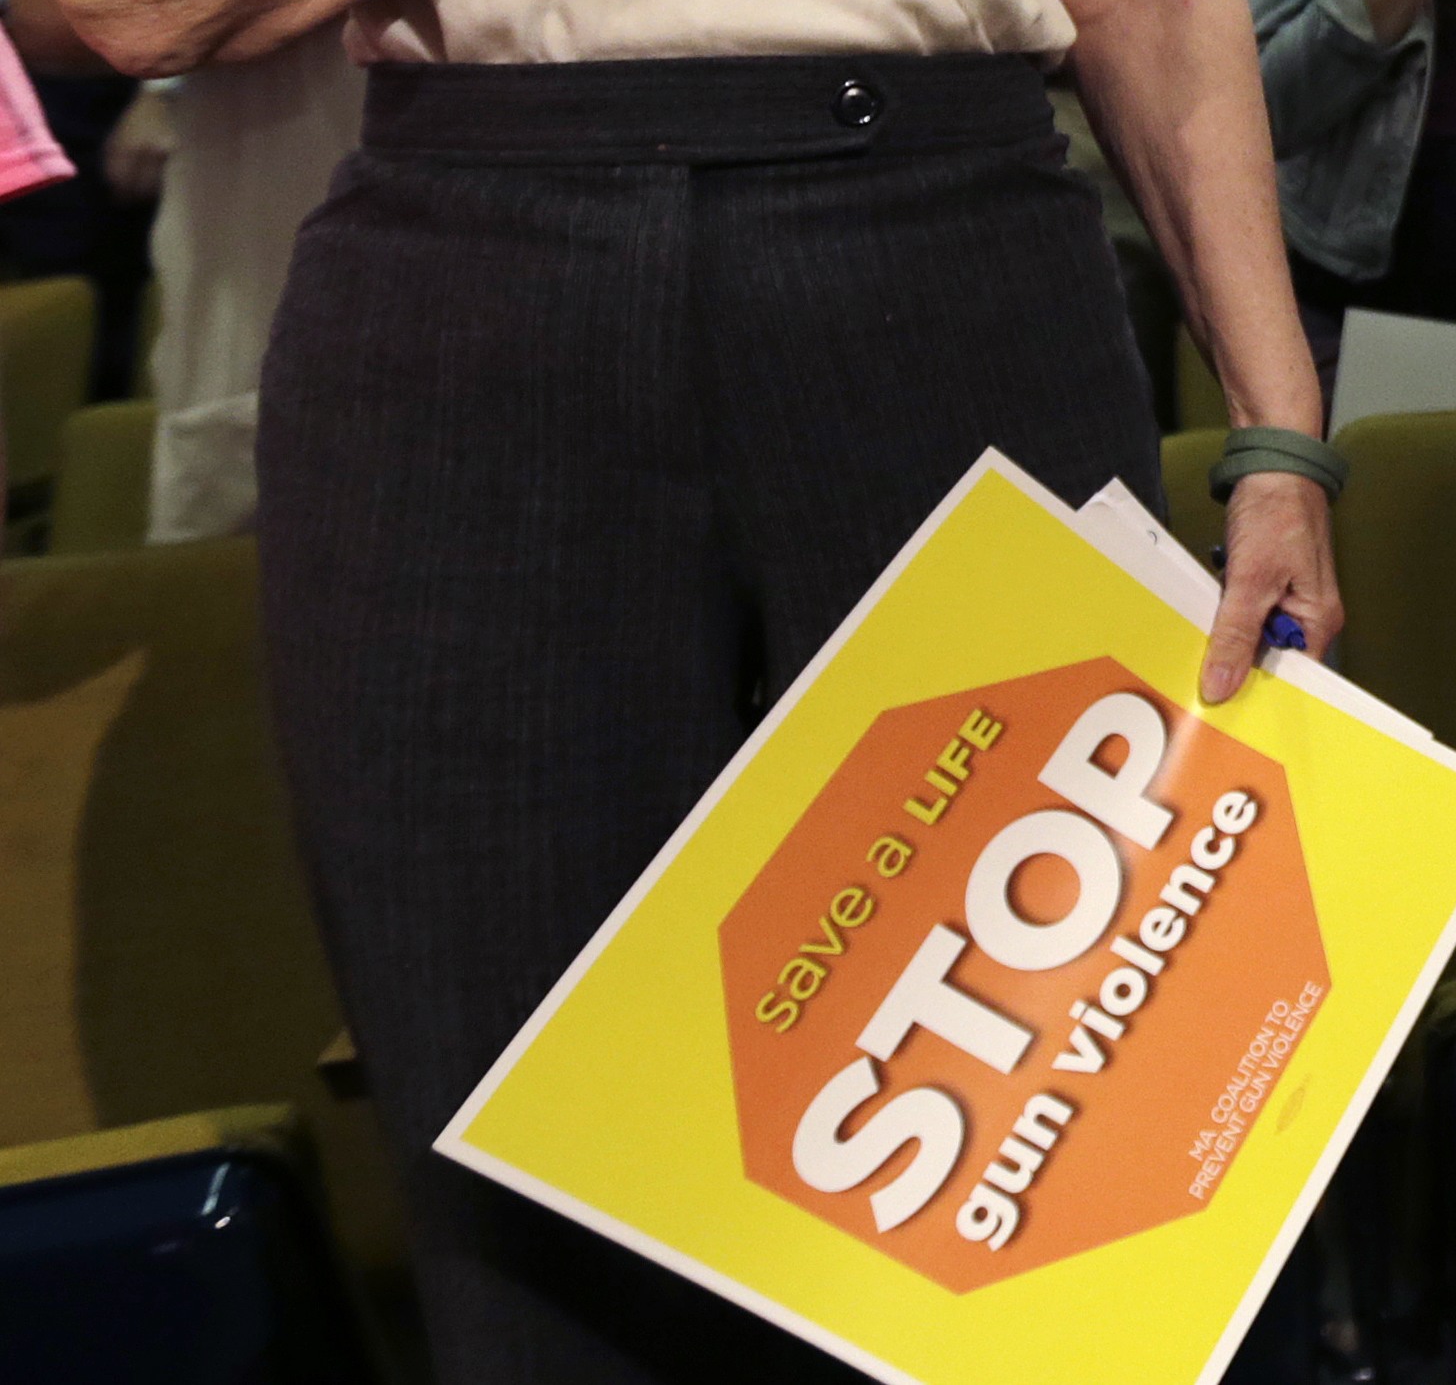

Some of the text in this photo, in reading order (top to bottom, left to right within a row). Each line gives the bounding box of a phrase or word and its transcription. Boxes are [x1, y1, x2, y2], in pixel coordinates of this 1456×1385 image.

[755, 708, 1003, 1033] save a LIFE
[791, 689, 1176, 1234] STOP
[956, 790, 1258, 1252] gun violence
[1188, 1000, 1290, 1162] MA COALITION TO
[1188, 980, 1323, 1200] PREVENT GUN VIOLENCE
